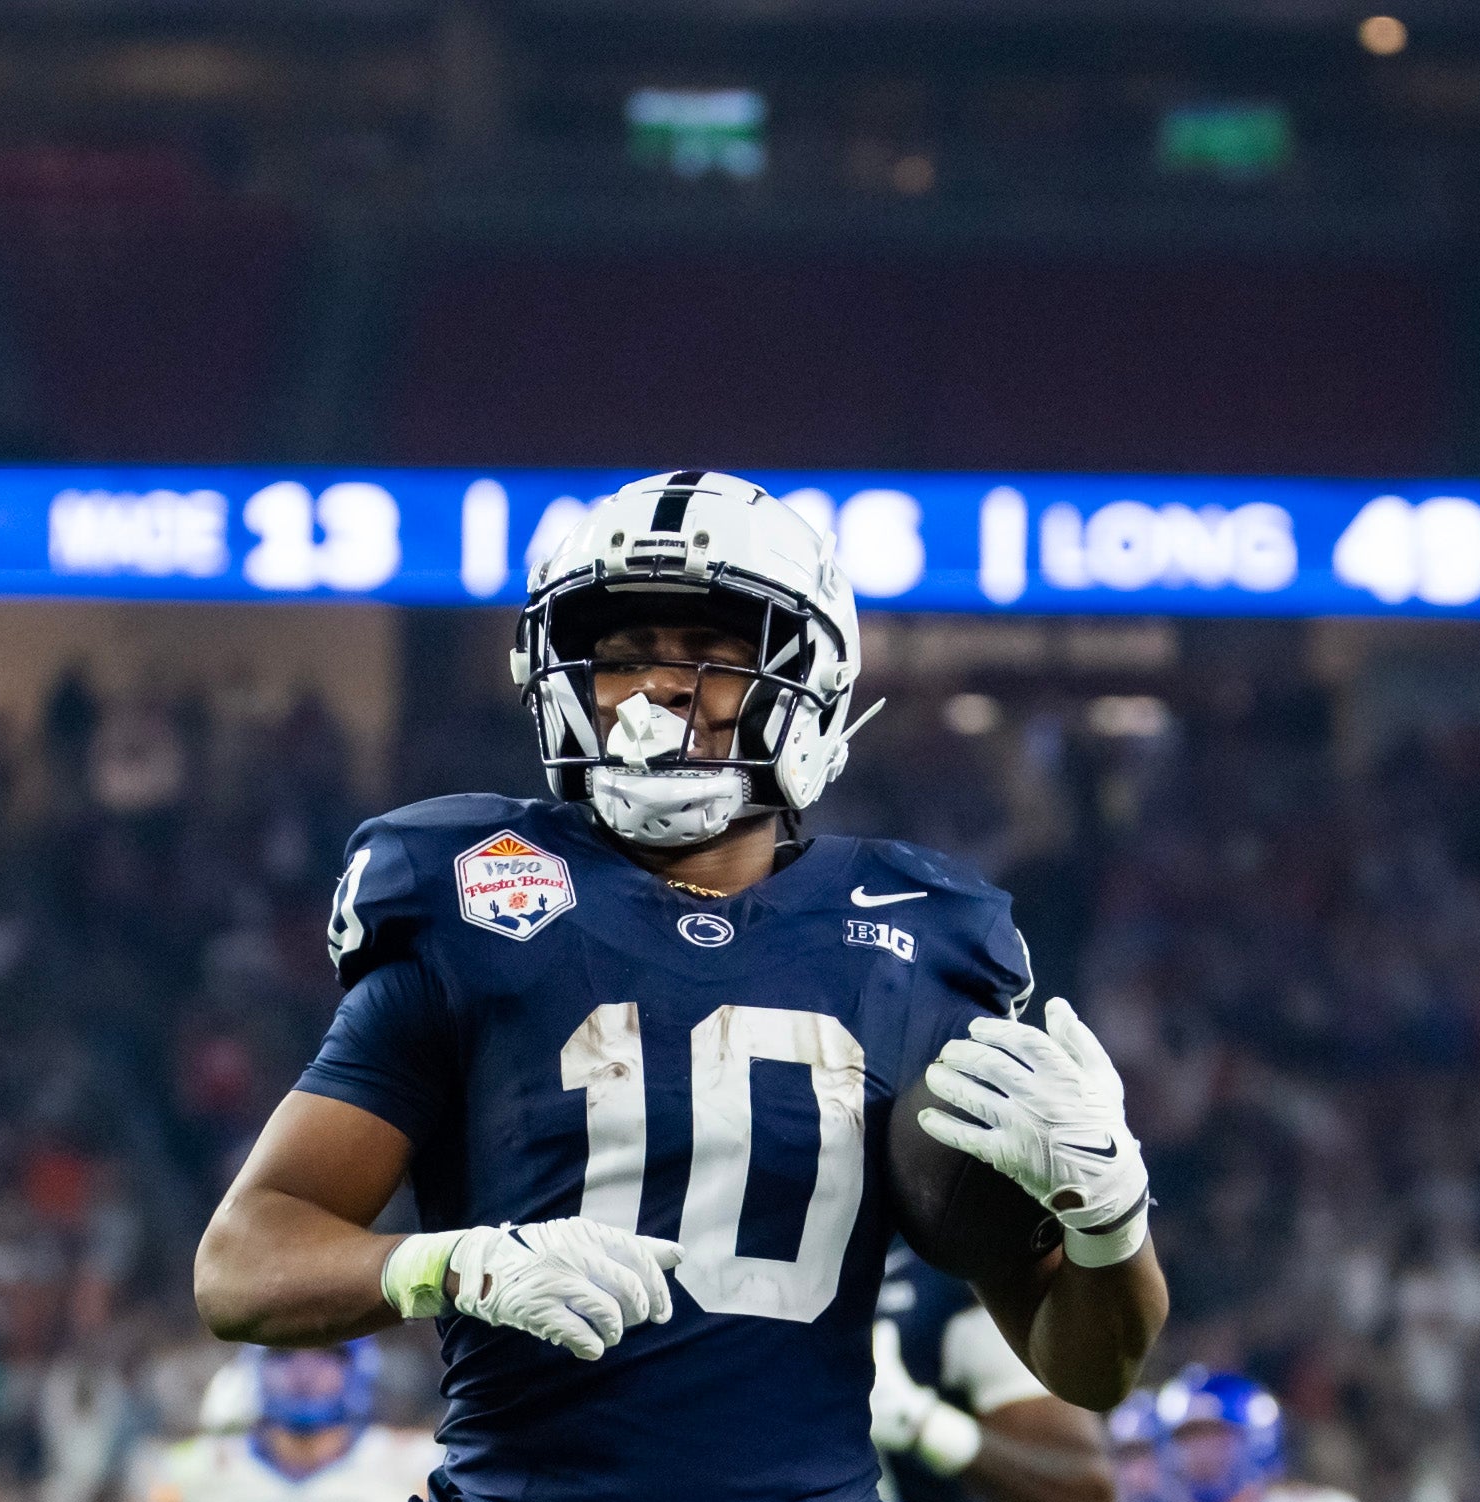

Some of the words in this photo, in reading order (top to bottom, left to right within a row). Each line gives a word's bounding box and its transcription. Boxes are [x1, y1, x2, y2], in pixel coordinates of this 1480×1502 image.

[242, 480, 402, 592] 13
[1039, 499, 1299, 593] LONG
[465, 878, 516, 898] Fiesta
[517, 875, 565, 890] Bowl
[483, 859, 543, 877] Vrbo
[560, 1001, 865, 1323] 10
